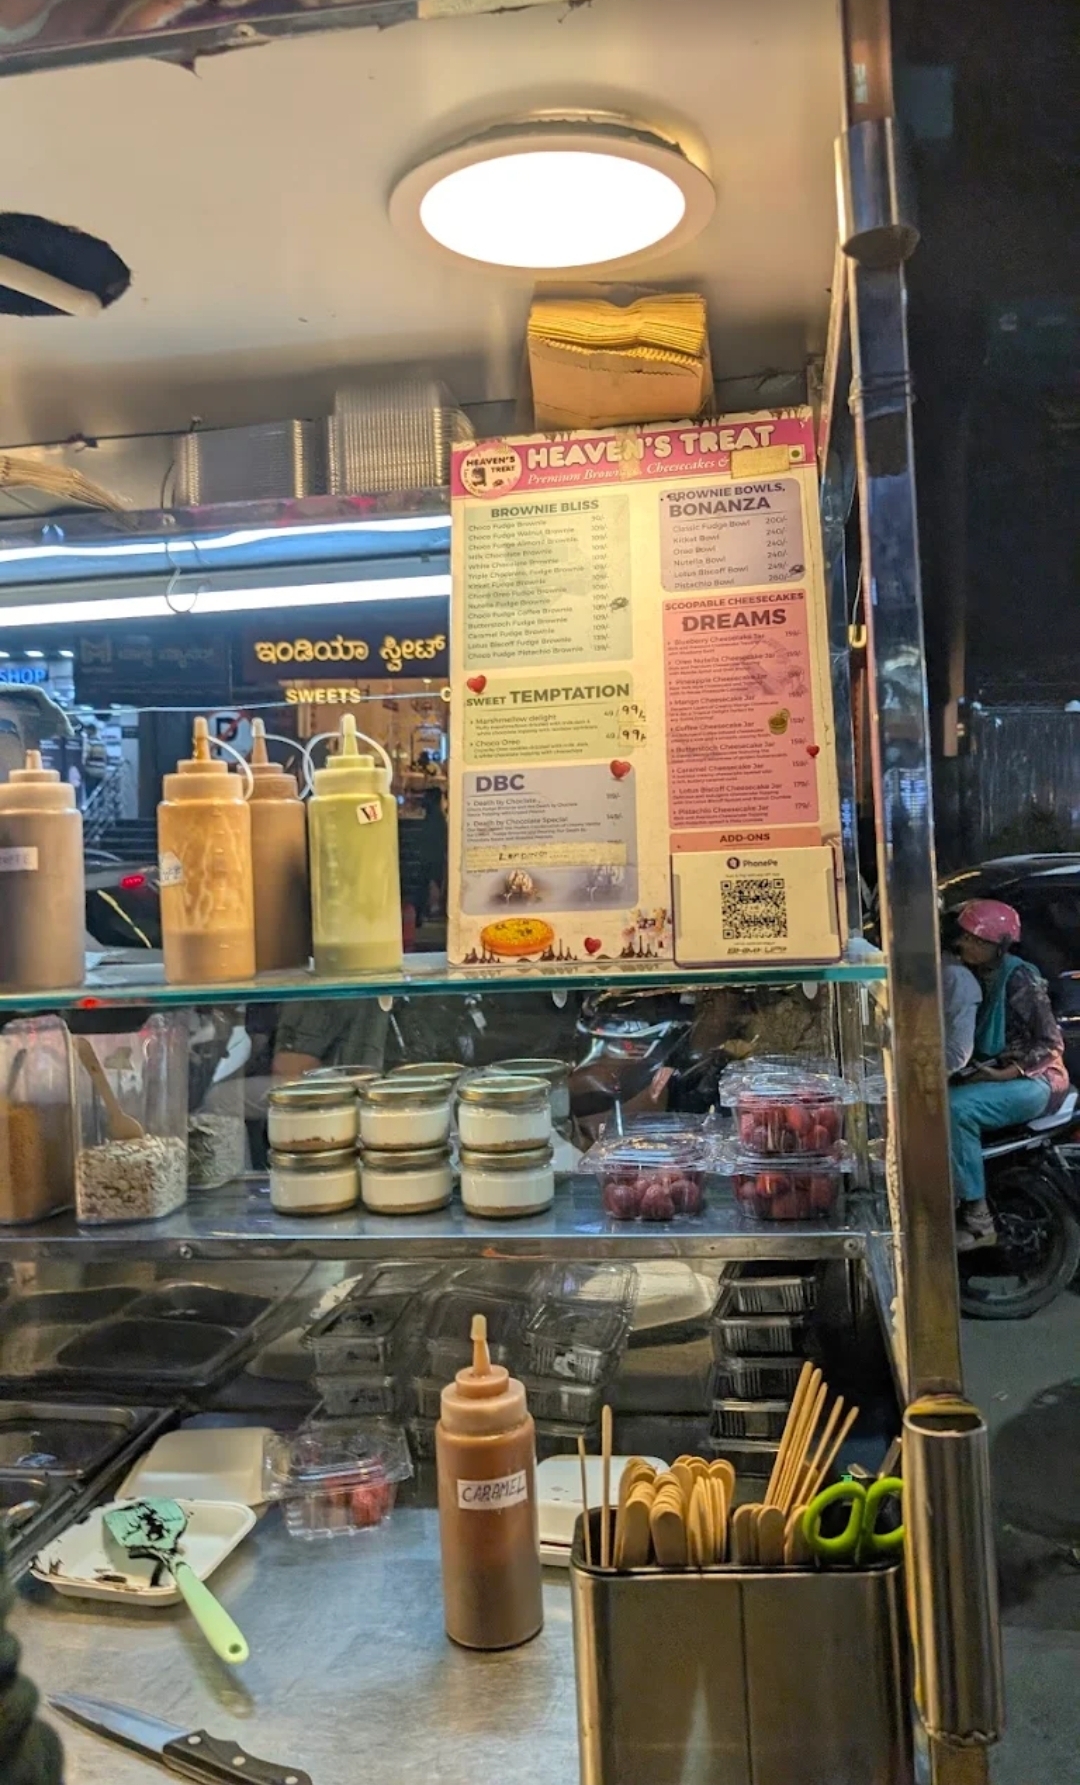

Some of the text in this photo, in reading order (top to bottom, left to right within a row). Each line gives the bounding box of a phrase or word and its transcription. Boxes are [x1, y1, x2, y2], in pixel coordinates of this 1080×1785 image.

[527, 425, 775, 471] HEAVEN'S TREAT
[466, 456, 516, 467] HEAVEN'S
[491, 465, 516, 473] TREAT
[527, 473, 582, 485] Premium
[646, 458, 716, 474] Cheesecakes
[669, 487, 731, 501] BROWNIE
[491, 500, 599, 518] BROWNIE BLISS
[670, 497, 771, 517] BONANZA
[673, 524, 700, 532] Classic
[702, 522, 727, 530] Fudge
[729, 519, 750, 527] Bowl
[493, 532, 515, 540] Fudge
[674, 558, 703, 566] Nutella
[706, 556, 726, 564] Bowl
[674, 570, 696, 578] Lotus
[675, 580, 712, 589] Pistachio
[665, 593, 803, 610] SCOOPABLE CHEESECAKES
[493, 610, 515, 618] Fudge
[542, 606, 572, 614] Brownie
[537, 617, 568, 625] Brownie
[683, 609, 786, 631] DREAMS
[468, 631, 497, 639] Caramel
[499, 630, 523, 638] Fudge
[490, 640, 514, 648] Biscoff
[516, 638, 539, 646] Fudge
[541, 636, 572, 644] Brownie
[675, 638, 708, 646] Blueberry
[710, 634, 752, 642] Cheesecake
[254, 634, 369, 664] ಇಂಡಿಯಾ
[518, 648, 551, 656] Pistachio
[553, 646, 583, 654] Brownie
[693, 656, 719, 664] Nutella
[675, 677, 711, 685] Pineapple
[285, 688, 362, 704] SWEETS
[466, 683, 630, 706] SWEET TEMPTATION
[529, 714, 557, 722] delight
[700, 722, 742, 730] Cheesecake
[720, 742, 762, 750] Cheesecake
[676, 765, 707, 773] Caramel
[708, 763, 751, 771] Cheesecake
[476, 774, 525, 792] DBC
[701, 785, 725, 793] Biscoff
[726, 783, 769, 791] Cheesecake
[713, 805, 756, 813] Cheesecake
[542, 816, 568, 824] Special
[720, 833, 770, 842] ADD-ONS
[743, 859, 778, 867] PhonePe
[462, 1474, 525, 1503] CARAMEL
